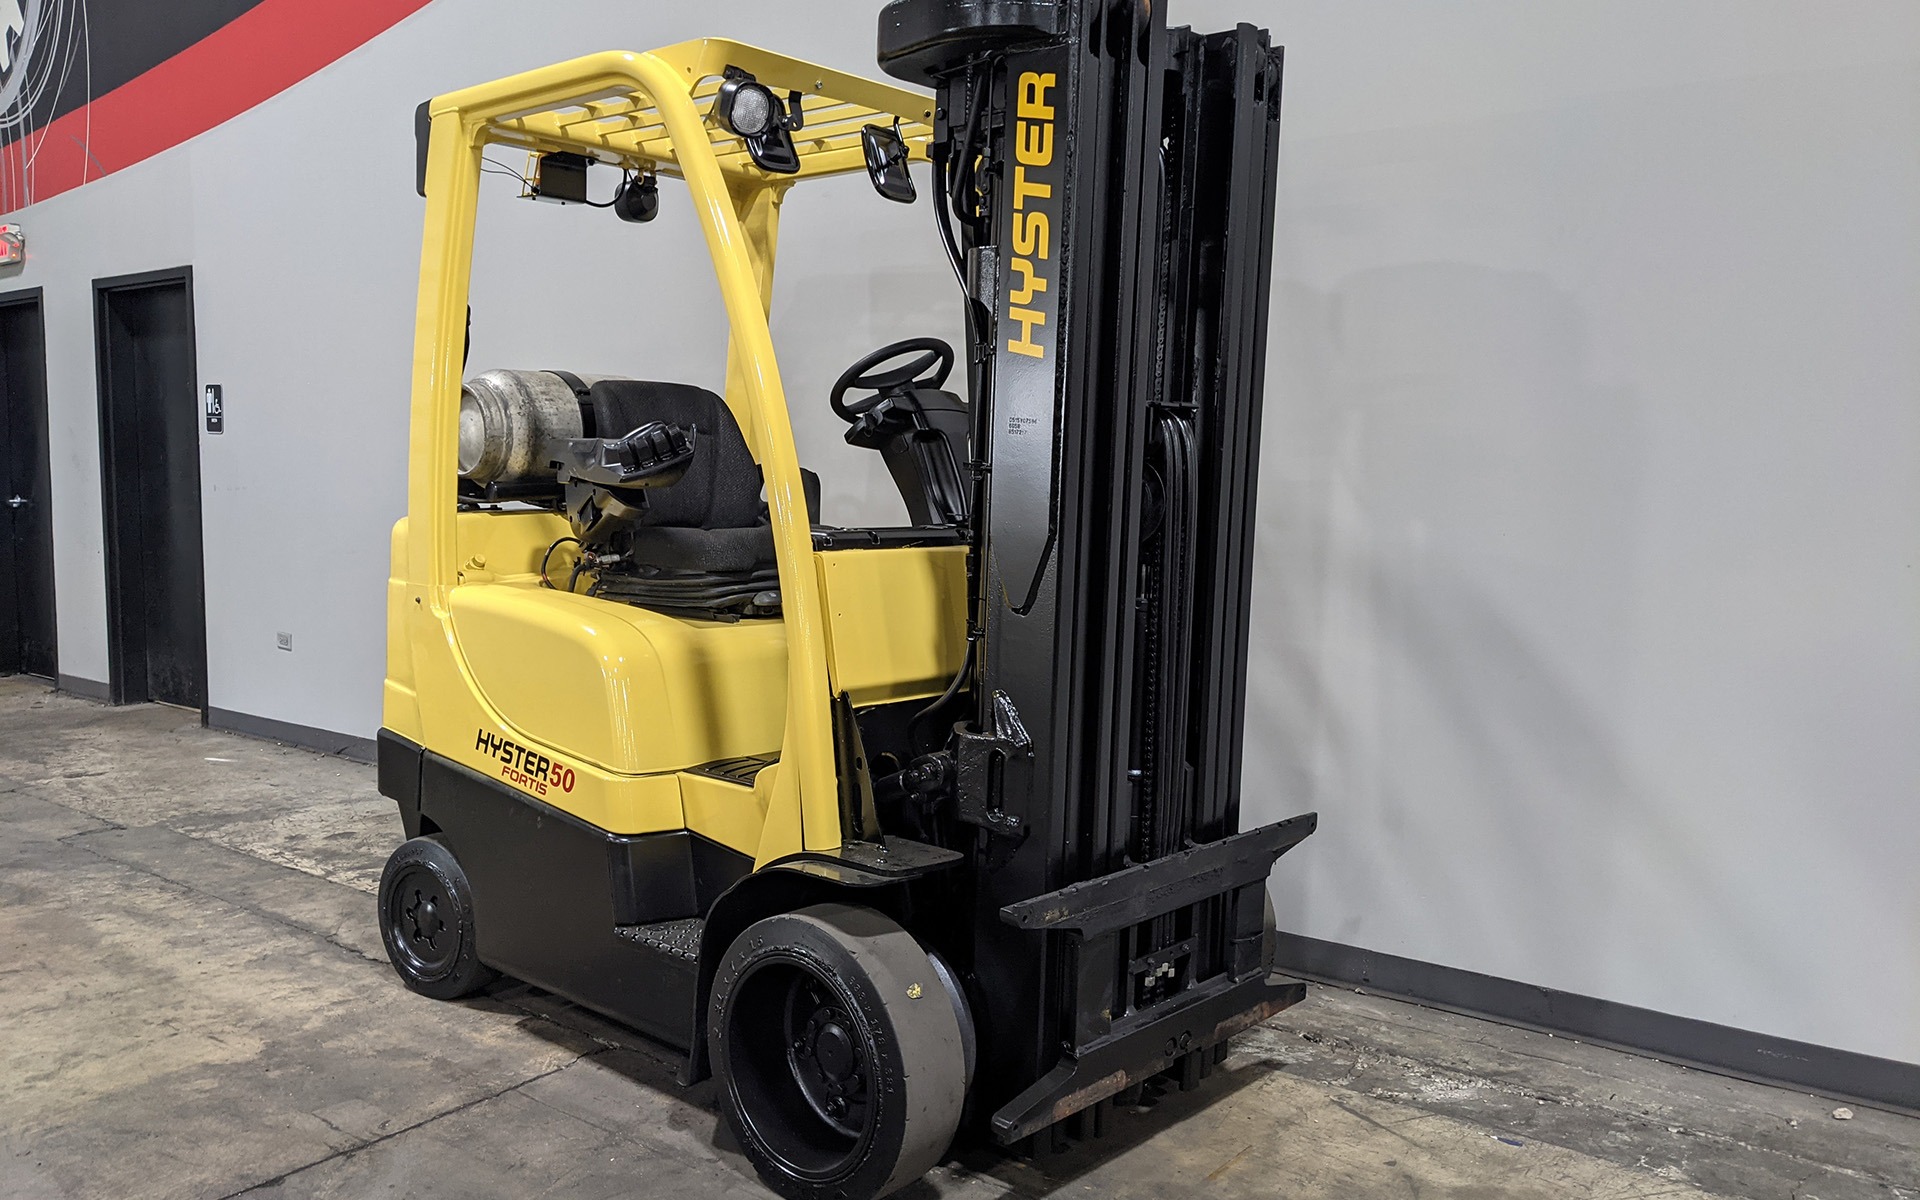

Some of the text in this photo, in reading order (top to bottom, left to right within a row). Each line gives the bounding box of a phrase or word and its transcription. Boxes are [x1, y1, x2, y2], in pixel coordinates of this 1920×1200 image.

[1008, 71, 1056, 358] HYSTER
[475, 729, 575, 793] HYSTER 50
[501, 765, 548, 796] FORTIS
